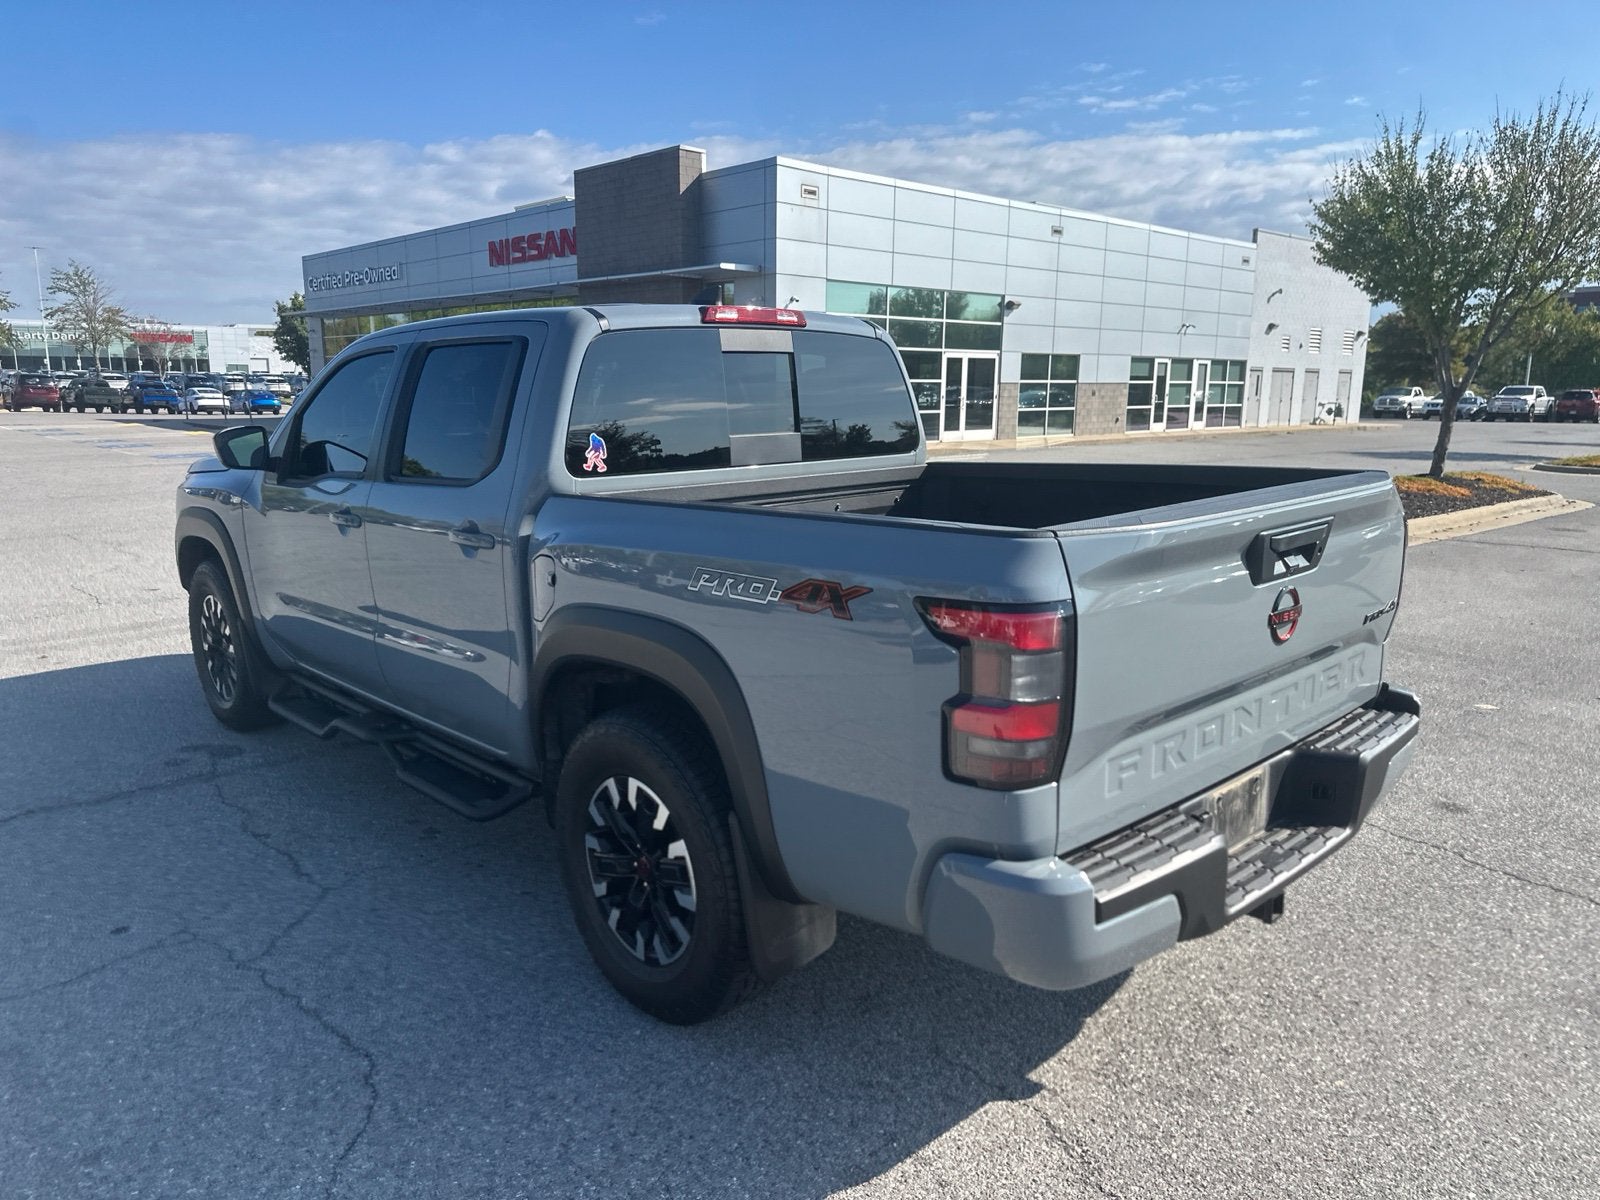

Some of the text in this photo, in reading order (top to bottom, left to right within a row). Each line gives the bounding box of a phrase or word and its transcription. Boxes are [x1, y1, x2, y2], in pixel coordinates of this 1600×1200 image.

[488, 226, 577, 267] NISSAN
[307, 263, 398, 291] Certified Pre-Owned
[1105, 650, 1366, 799] FRONTIER
